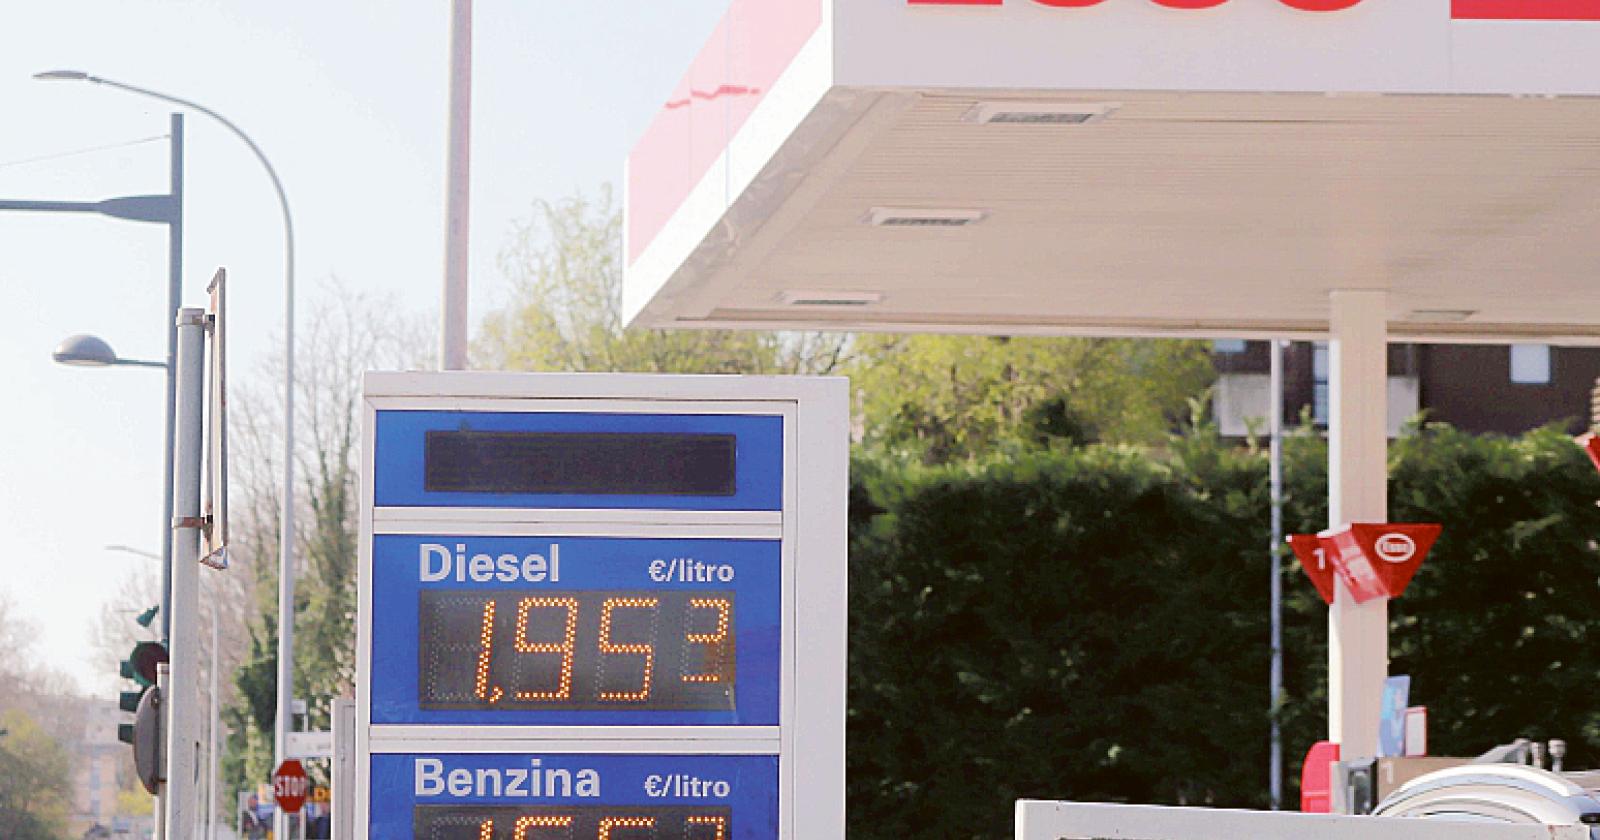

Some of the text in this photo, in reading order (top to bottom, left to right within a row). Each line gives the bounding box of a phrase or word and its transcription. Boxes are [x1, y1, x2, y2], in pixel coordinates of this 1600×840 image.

[419, 543, 559, 582] Diesel
[1312, 547, 1326, 570] 1
[648, 559, 735, 583] €/litro
[414, 758, 601, 798] Benzina
[644, 774, 731, 798] €/litro
